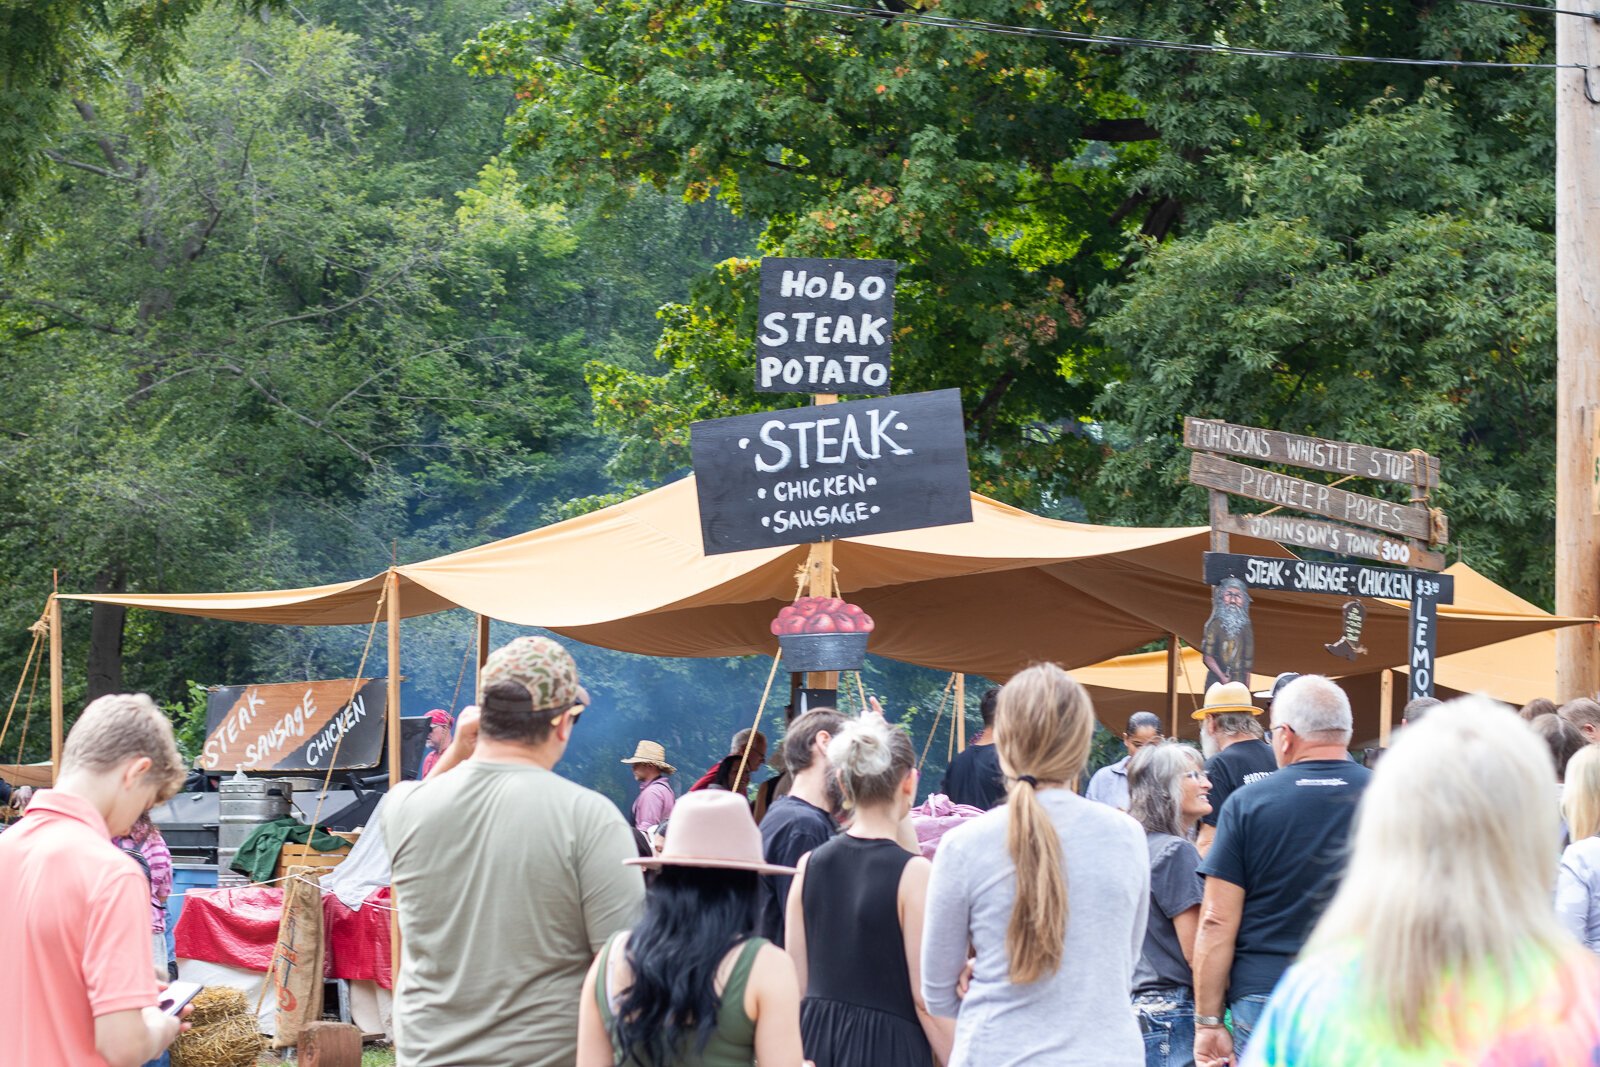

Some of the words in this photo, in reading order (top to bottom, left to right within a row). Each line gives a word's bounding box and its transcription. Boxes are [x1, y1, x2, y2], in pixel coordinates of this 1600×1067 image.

[760, 311, 888, 347] STEAK
[760, 355, 888, 388] POTATO
[755, 409, 914, 473] STEAK
[1286, 440, 1361, 471] WHISTLE
[1368, 451, 1414, 480] STOP
[773, 473, 867, 502] CHICKEN
[1240, 467, 1330, 512] PIONEER
[1345, 494, 1405, 531] POKES
[773, 502, 870, 533] SAUSAGE
[1251, 517, 1340, 548] JOHNSON'S
[1381, 540, 1410, 563] 300
[1245, 559, 1284, 586] STEAK
[1294, 562, 1348, 593] SAUSAGE
[1358, 573, 1412, 600] CHICKEN
[1413, 597, 1430, 699] LEMO
[204, 689, 266, 768] STEAK
[306, 695, 367, 765] CHICKEN
